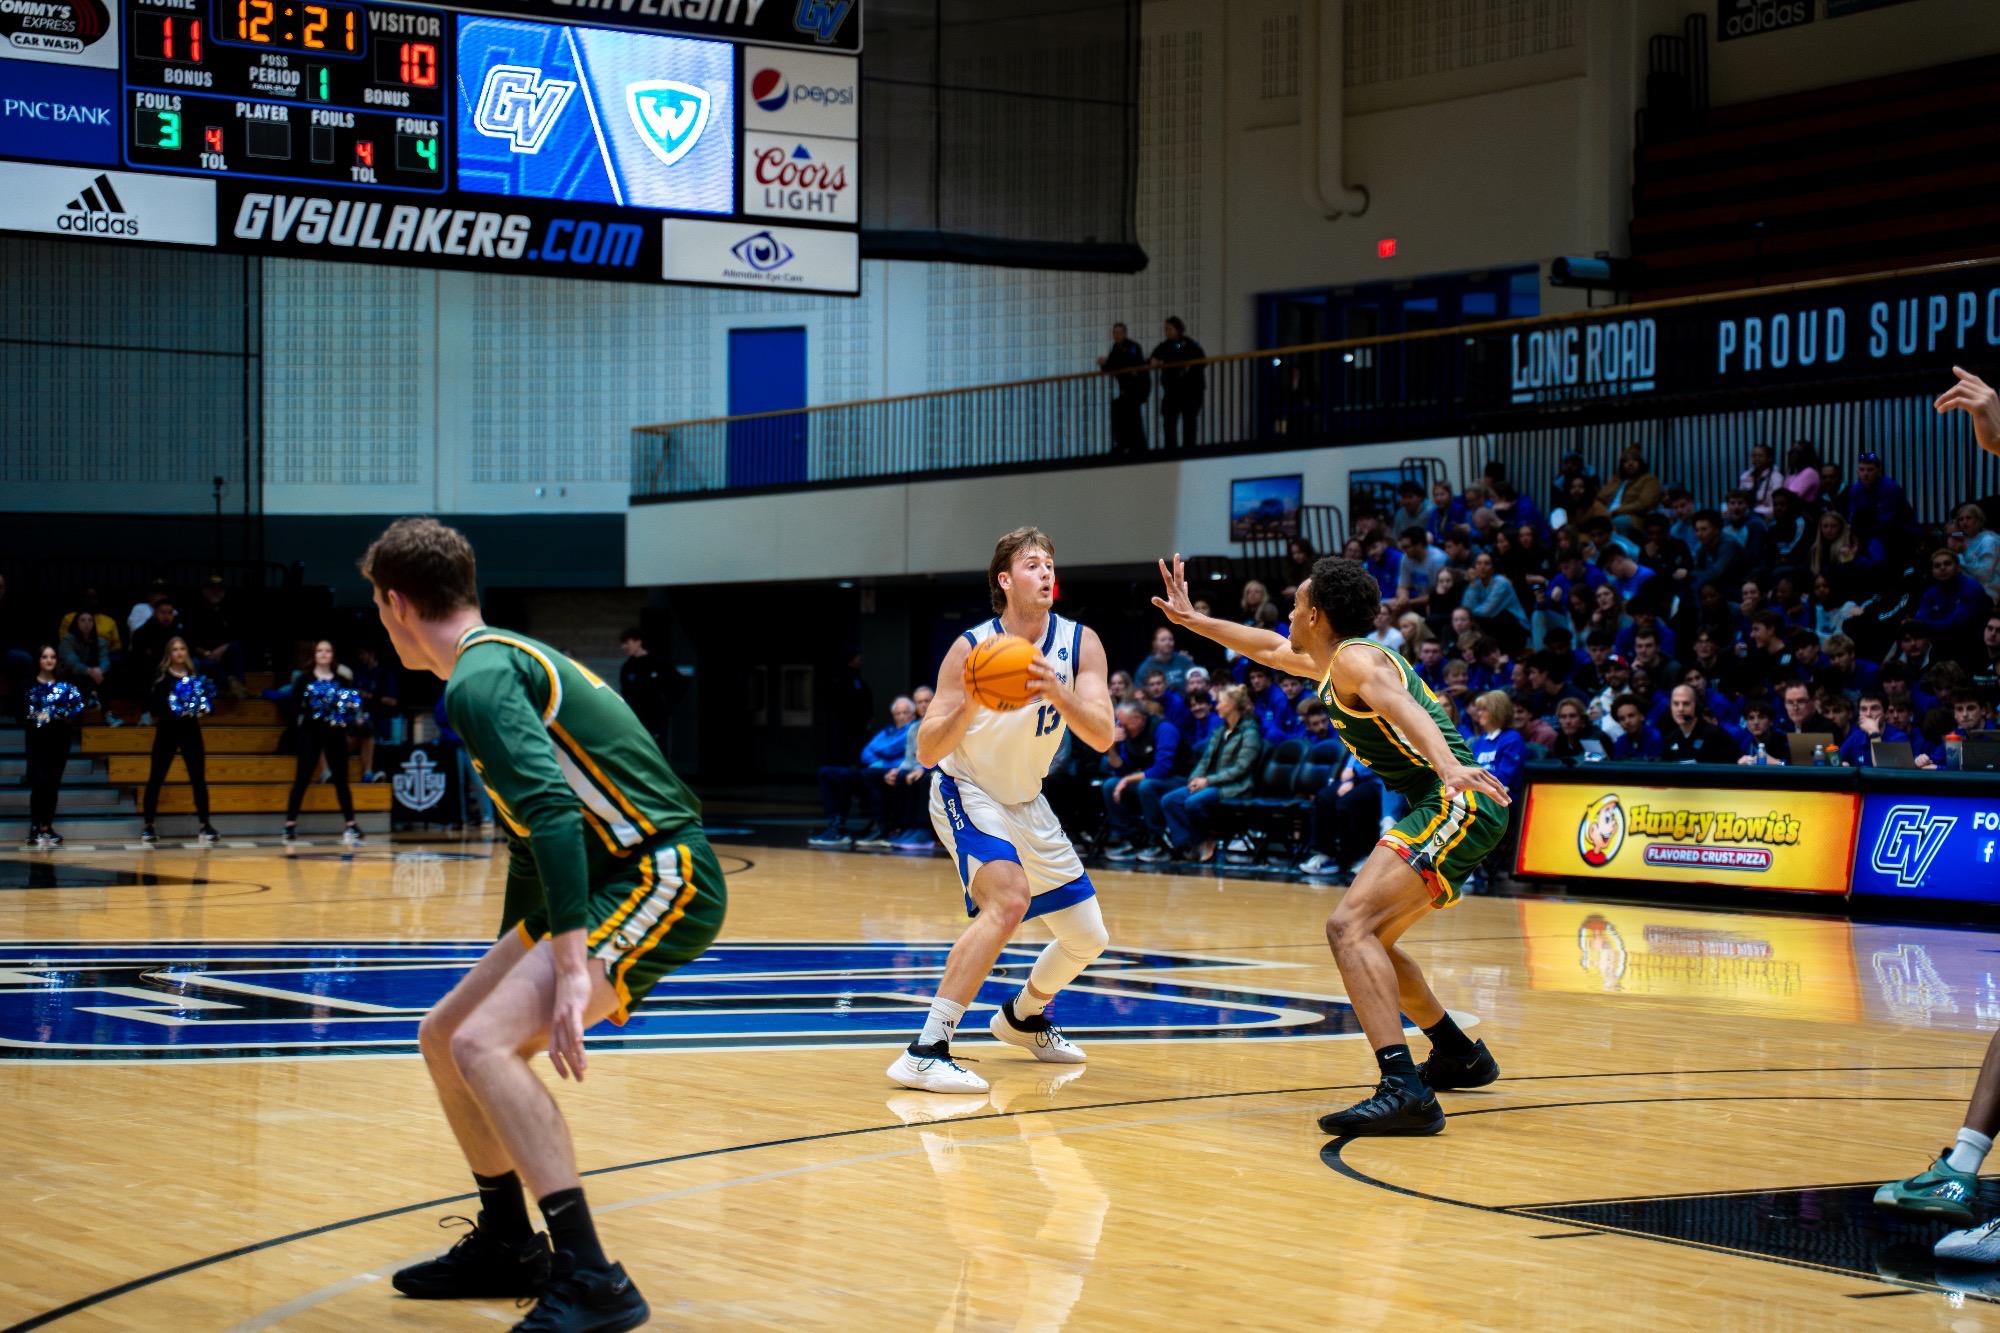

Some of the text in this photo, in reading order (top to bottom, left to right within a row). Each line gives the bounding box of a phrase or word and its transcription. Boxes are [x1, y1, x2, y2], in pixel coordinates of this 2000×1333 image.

[0, 0, 71, 19] OMMY'S
[1727, 1, 1805, 36] adidas
[22, 16, 76, 32] EXPRESS
[238, 0, 354, 50] 12:21
[368, 10, 441, 37] VISITOR
[14, 35, 79, 49] CAR WASH
[163, 16, 200, 62] 11
[260, 53, 289, 67] POSS
[401, 42, 435, 87] 10
[164, 68, 213, 87] BONUS
[249, 66, 300, 86] PERIOD
[319, 67, 328, 100] 1
[136, 92, 182, 111] FOULS
[364, 87, 411, 107] BONUS
[793, 84, 854, 107] pepsi
[5, 98, 111, 126] PNC BANK
[236, 102, 289, 121] PLAYER
[311, 109, 355, 128] FOULS
[158, 112, 180, 148] 3
[396, 117, 439, 136] FOULS
[205, 128, 221, 152] 4
[200, 152, 228, 170] TOL
[355, 142, 373, 167] 4
[416, 138, 437, 171] 4
[350, 166, 378, 183] TOL
[753, 147, 848, 192] Coors
[765, 188, 838, 213] LIGHT
[57, 209, 139, 236] adidas
[233, 192, 645, 268] GVSULAKERS.COM
[1718, 307, 1846, 375] PROUD
[1511, 317, 1657, 390] LONG ROAD
[1536, 381, 1629, 403] DISTILLERS
[1035, 703, 1062, 737] 13
[1628, 804, 1801, 846] Hungry Howie's
[1973, 811, 2000, 831] FO
[1648, 848, 1699, 862] FLAVORED
[1736, 853, 1767, 866] PIZZA
